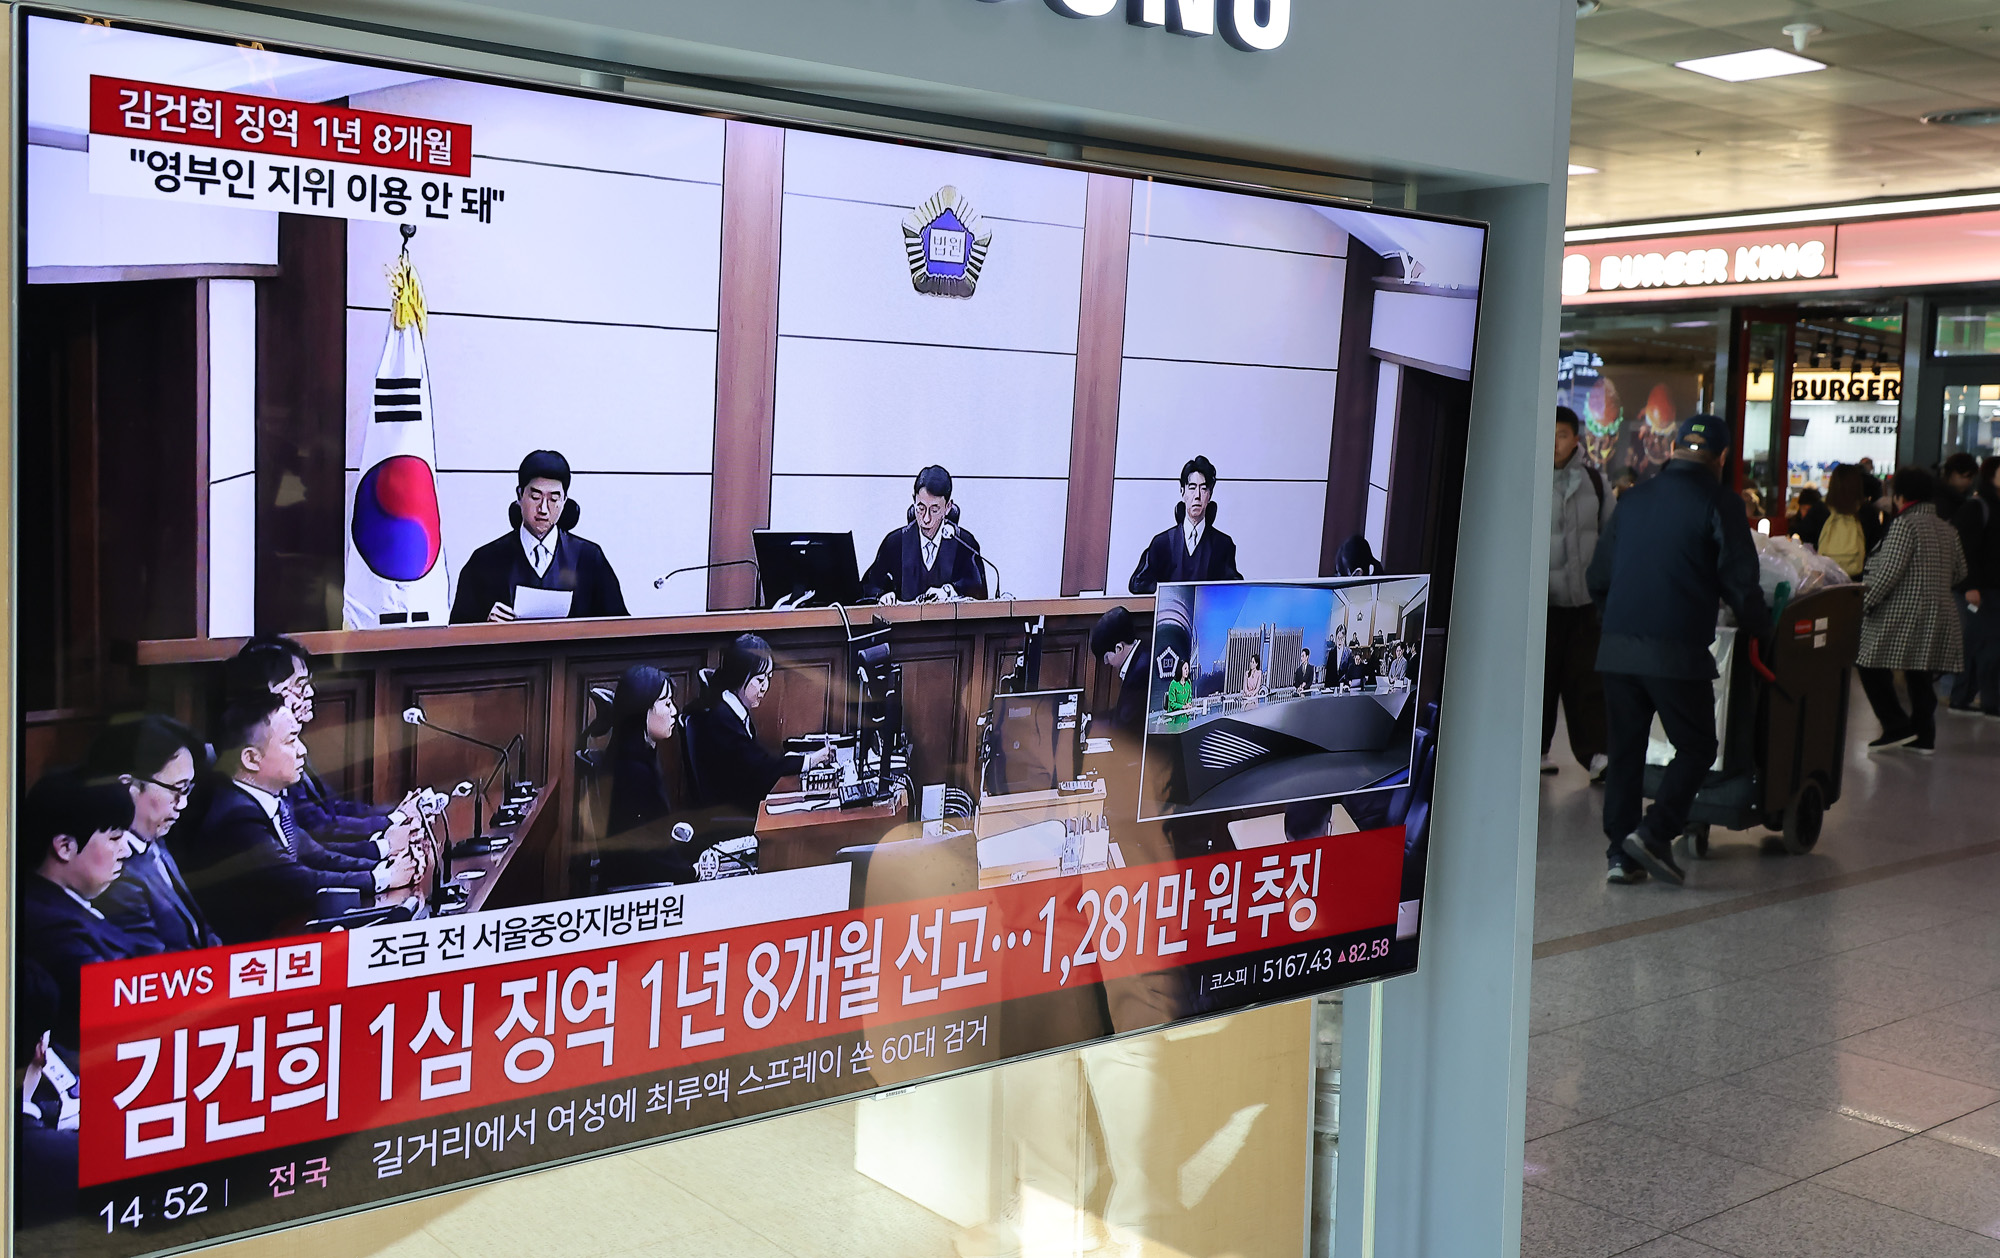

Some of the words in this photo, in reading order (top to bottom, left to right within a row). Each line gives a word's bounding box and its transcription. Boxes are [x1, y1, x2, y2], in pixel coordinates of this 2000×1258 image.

[119, 88, 222, 139] 김건희
[234, 103, 299, 148] 징역
[313, 116, 362, 155] 1년
[372, 126, 452, 167] 8개월
[130, 149, 255, 200] "영부인
[268, 164, 335, 208] 지위
[347, 174, 412, 216] 이용
[421, 181, 453, 220] 안
[933, 235, 962, 257] 법원
[1600, 248, 1729, 290] BURGER
[1734, 240, 1825, 282] KING
[1793, 379, 1901, 401] BURGER
[1835, 415, 1871, 424] FLAME
[367, 931, 428, 970] 조금
[435, 922, 467, 960] 전
[473, 893, 685, 952] 서울중앙지방법원
[113, 966, 214, 1007] NEWS
[238, 950, 315, 981] 속보
[1210, 966, 1248, 991] 코스피
[1262, 948, 1332, 983] 5167.43
[112, 1003, 343, 1161] 김건희
[367, 982, 475, 1101] 1심
[493, 961, 618, 1084] 징역
[640, 942, 729, 1050] 1년
[743, 917, 884, 1029] 8개월
[1203, 860, 1242, 947] 원
[1248, 847, 1322, 938] 추징
[371, 1116, 538, 1180] 길거리에서
[546, 1088, 638, 1137] 여성에
[645, 1071, 729, 1115] 최루액
[737, 1045, 843, 1096] 스프레이
[849, 1041, 875, 1075] 쏜
[880, 1027, 937, 1066] 60대
[943, 1015, 989, 1052] 검거
[885, 1089, 907, 1097] SAMSUNG
[269, 1156, 331, 1199] 전국
